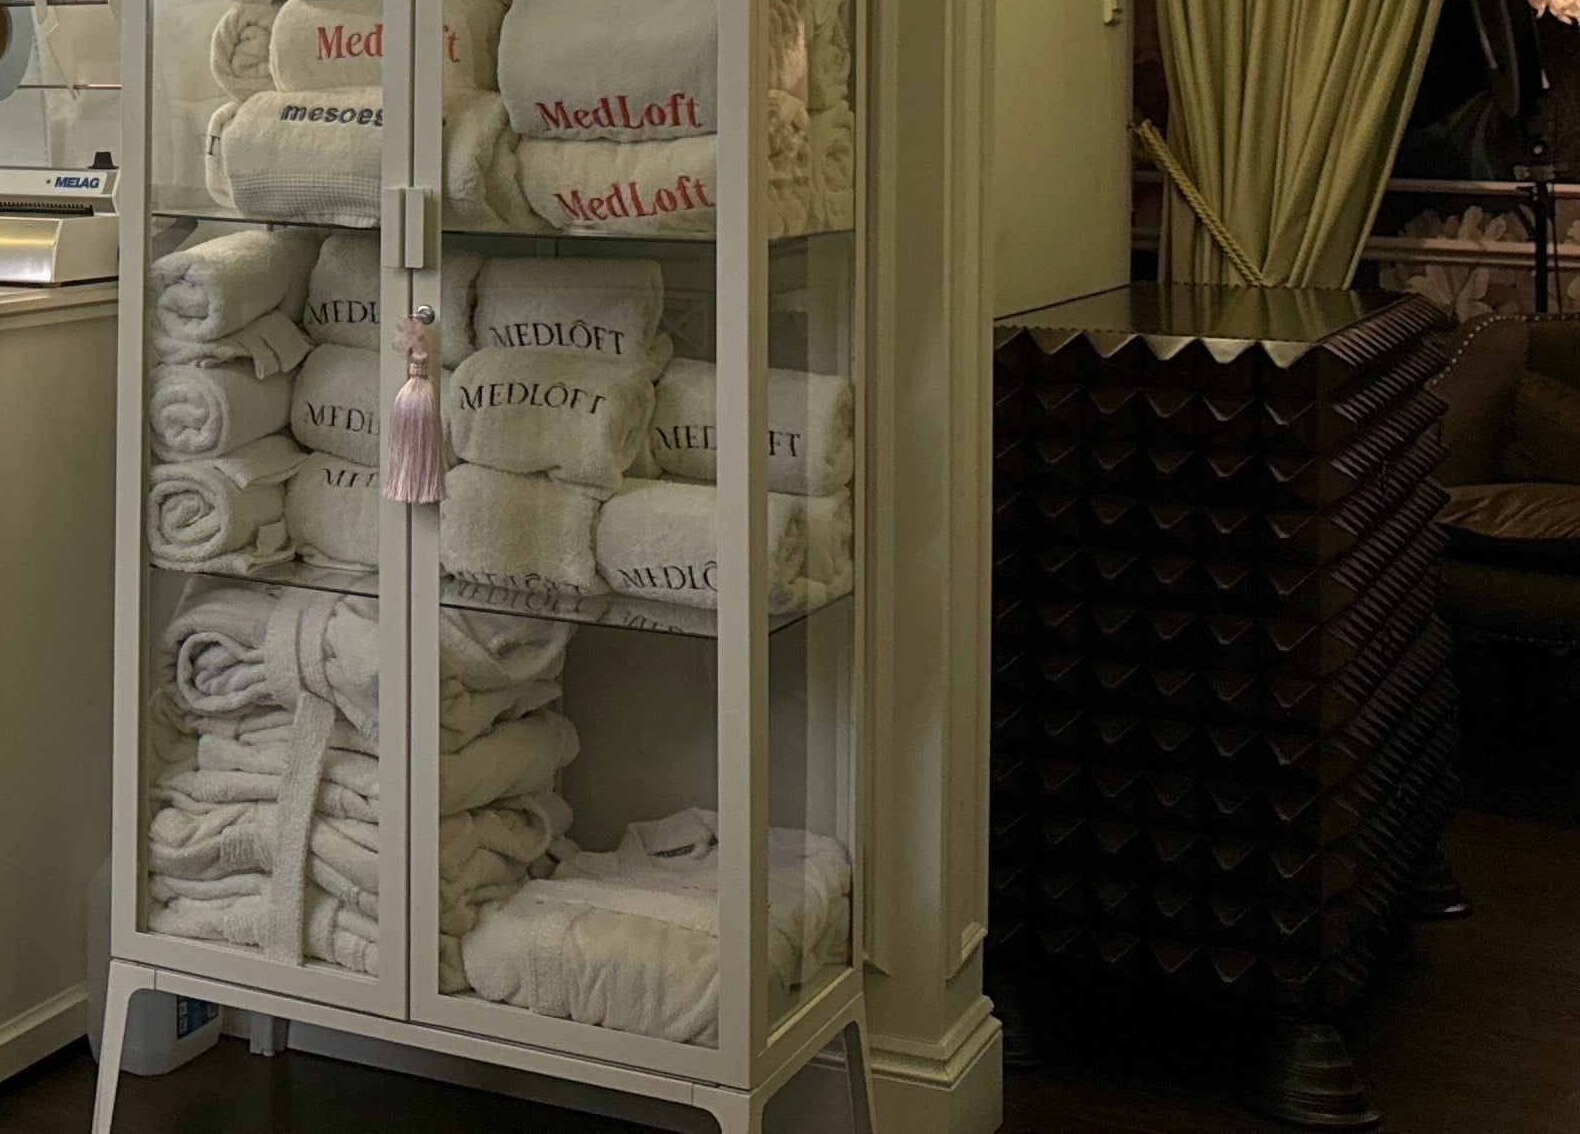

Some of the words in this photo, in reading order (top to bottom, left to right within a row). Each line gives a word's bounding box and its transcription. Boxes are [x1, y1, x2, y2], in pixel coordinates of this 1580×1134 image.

[535, 92, 702, 131] MedLoft
[55, 176, 100, 189] MELAG
[553, 175, 716, 222] MedLoft
[489, 319, 625, 355] MEDLÔFT
